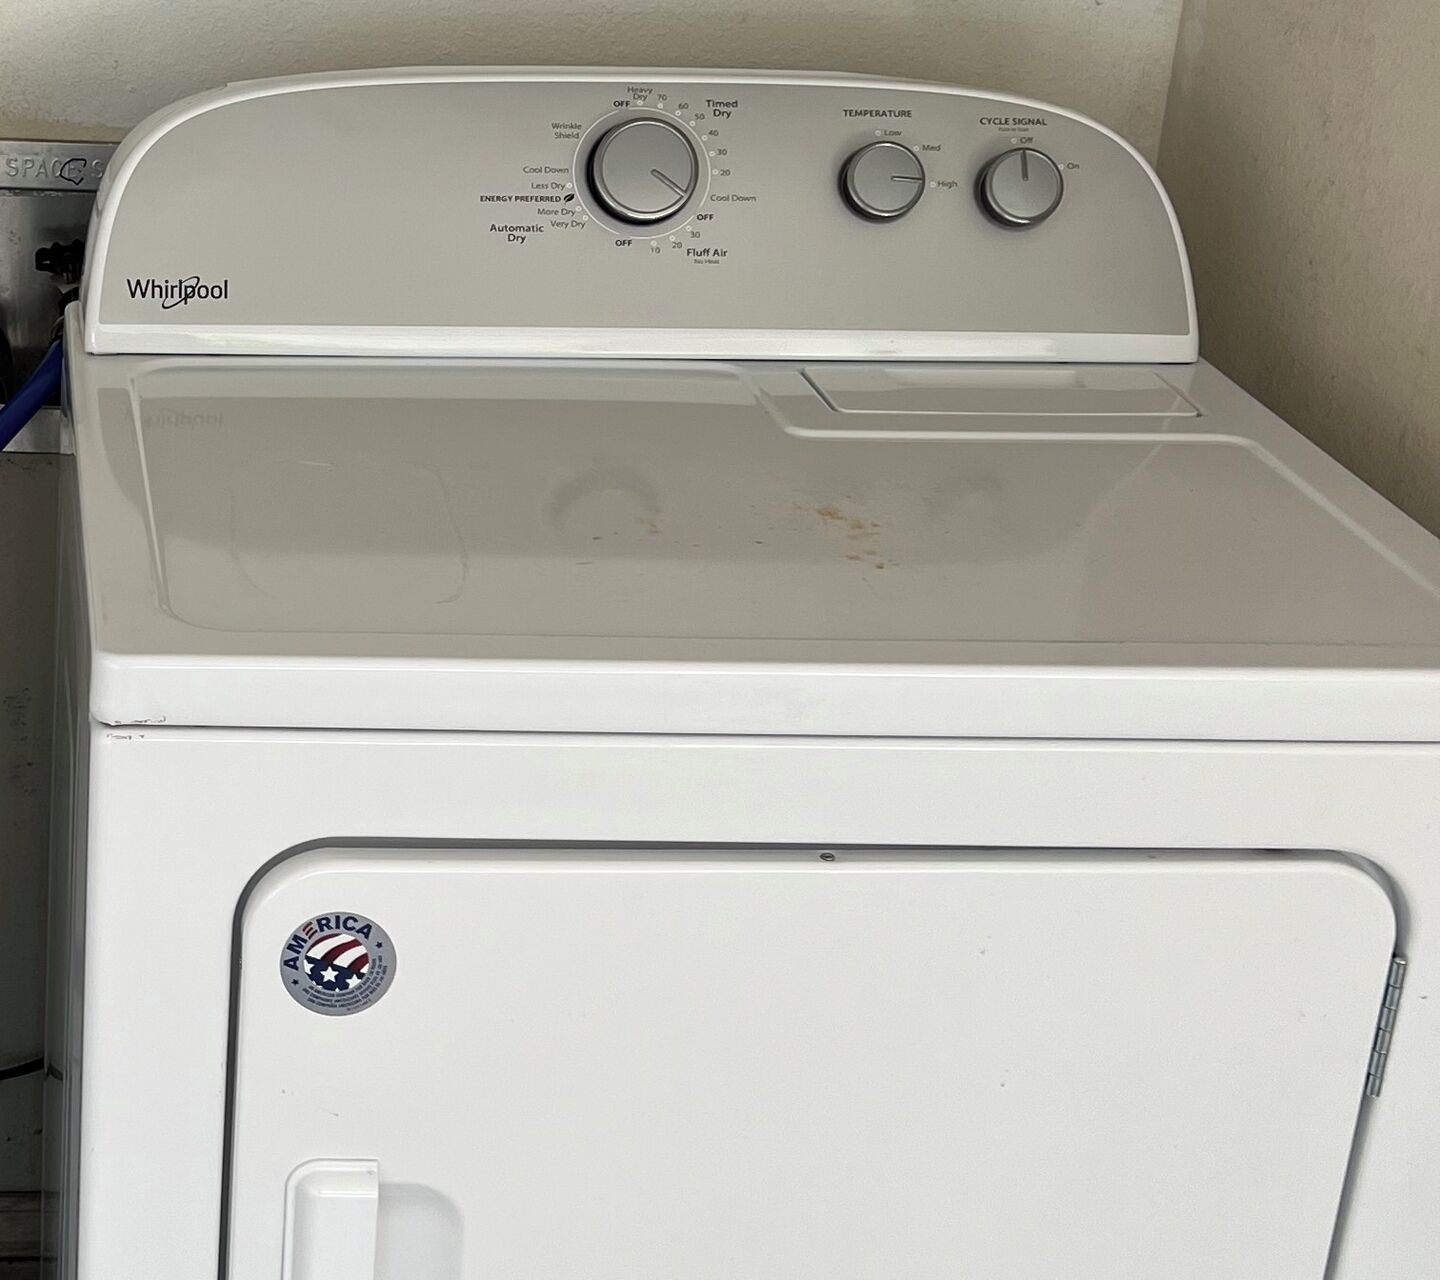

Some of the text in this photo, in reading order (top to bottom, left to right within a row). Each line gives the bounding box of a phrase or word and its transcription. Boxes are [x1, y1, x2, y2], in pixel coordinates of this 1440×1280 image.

[627, 86, 653, 95] Heavy
[633, 93, 649, 101] Dry
[706, 100, 738, 108] Timed
[713, 109, 732, 119] Dry
[842, 109, 912, 118] TEMPERATURE
[552, 122, 582, 130] Wrinkle
[979, 117, 1048, 126] CYCLE SIGNAL
[1020, 136, 1033, 144] Off
[523, 166, 569, 174] Cool Down
[1067, 162, 1080, 170] On
[551, 182, 566, 191] Dry
[937, 181, 958, 189] High
[480, 195, 562, 203] ENERGY PREFERRED
[710, 194, 757, 202] Cool Down
[561, 208, 576, 217] Dry
[490, 223, 544, 232] Automatic
[551, 220, 586, 229] Very Dry
[507, 233, 527, 244] Dry
[615, 239, 633, 247] OFF
[687, 248, 728, 257] Fluff Air
[126, 276, 228, 309] Whirlpool
[283, 914, 373, 971] AMERICA
